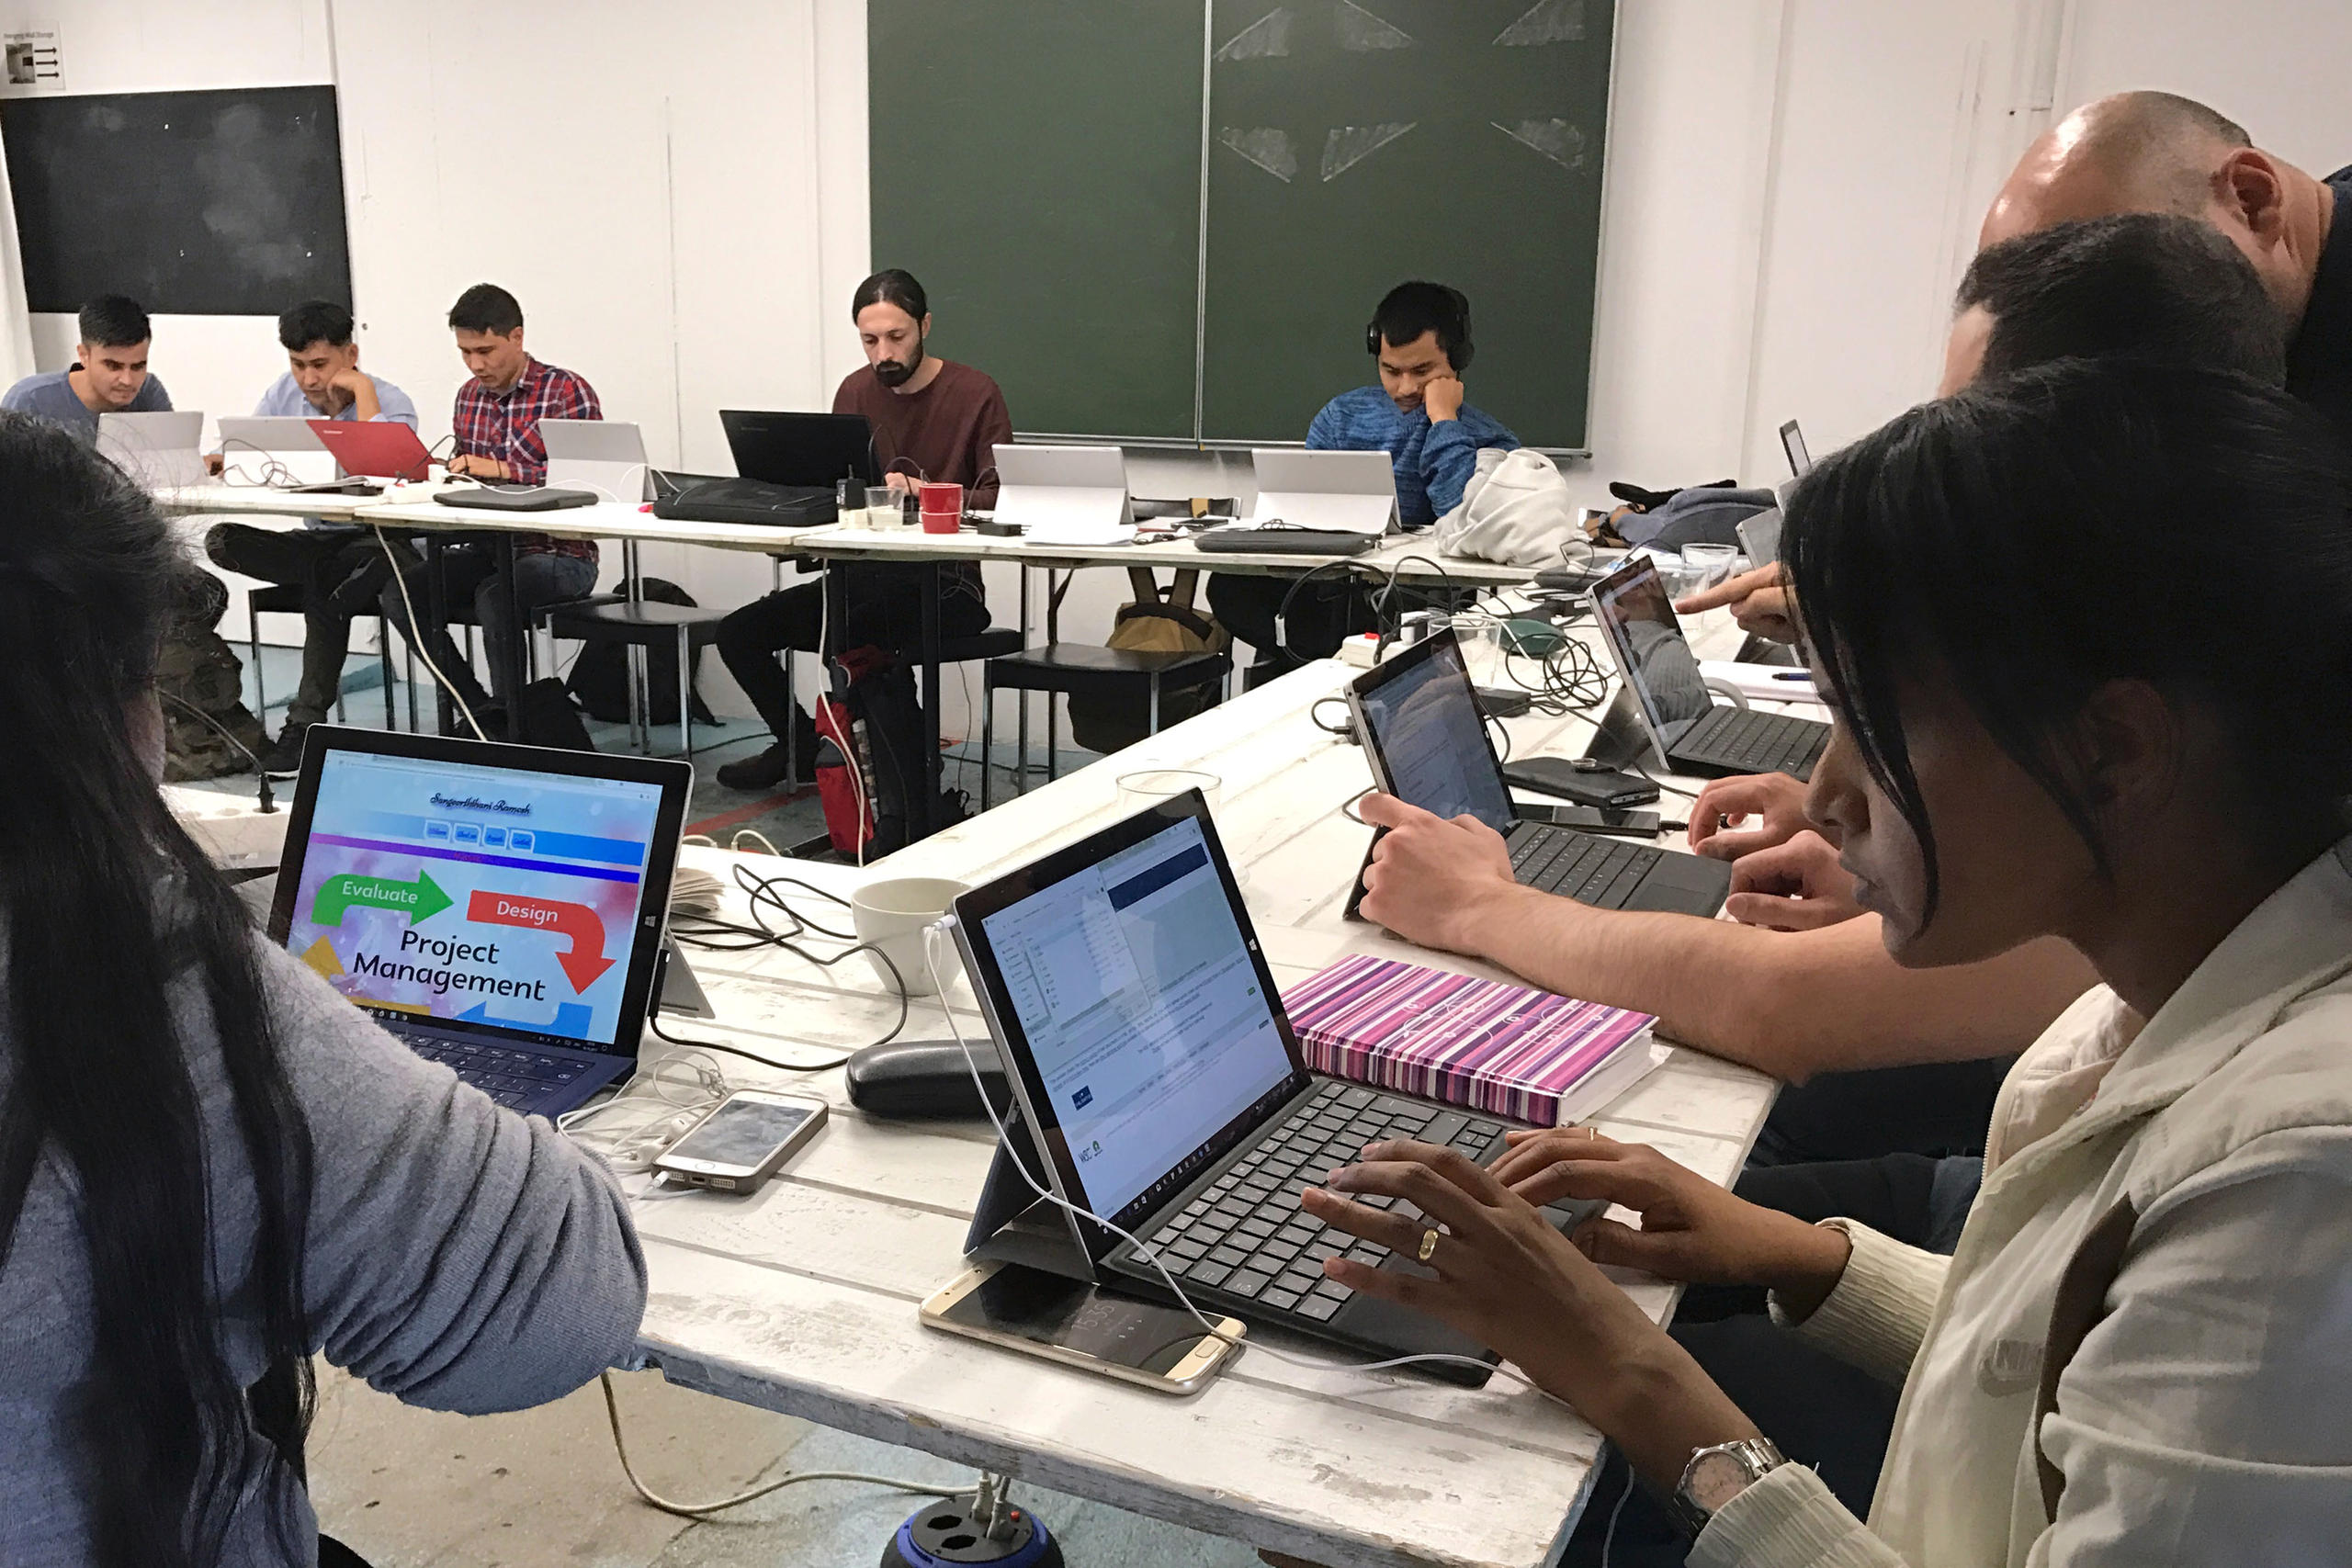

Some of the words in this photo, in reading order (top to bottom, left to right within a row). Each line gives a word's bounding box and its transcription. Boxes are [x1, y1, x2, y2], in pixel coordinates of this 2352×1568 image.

[342, 881, 418, 904] Evaluate
[497, 901, 559, 925] Design
[401, 930, 500, 965] Project
[353, 953, 547, 1001] Management
